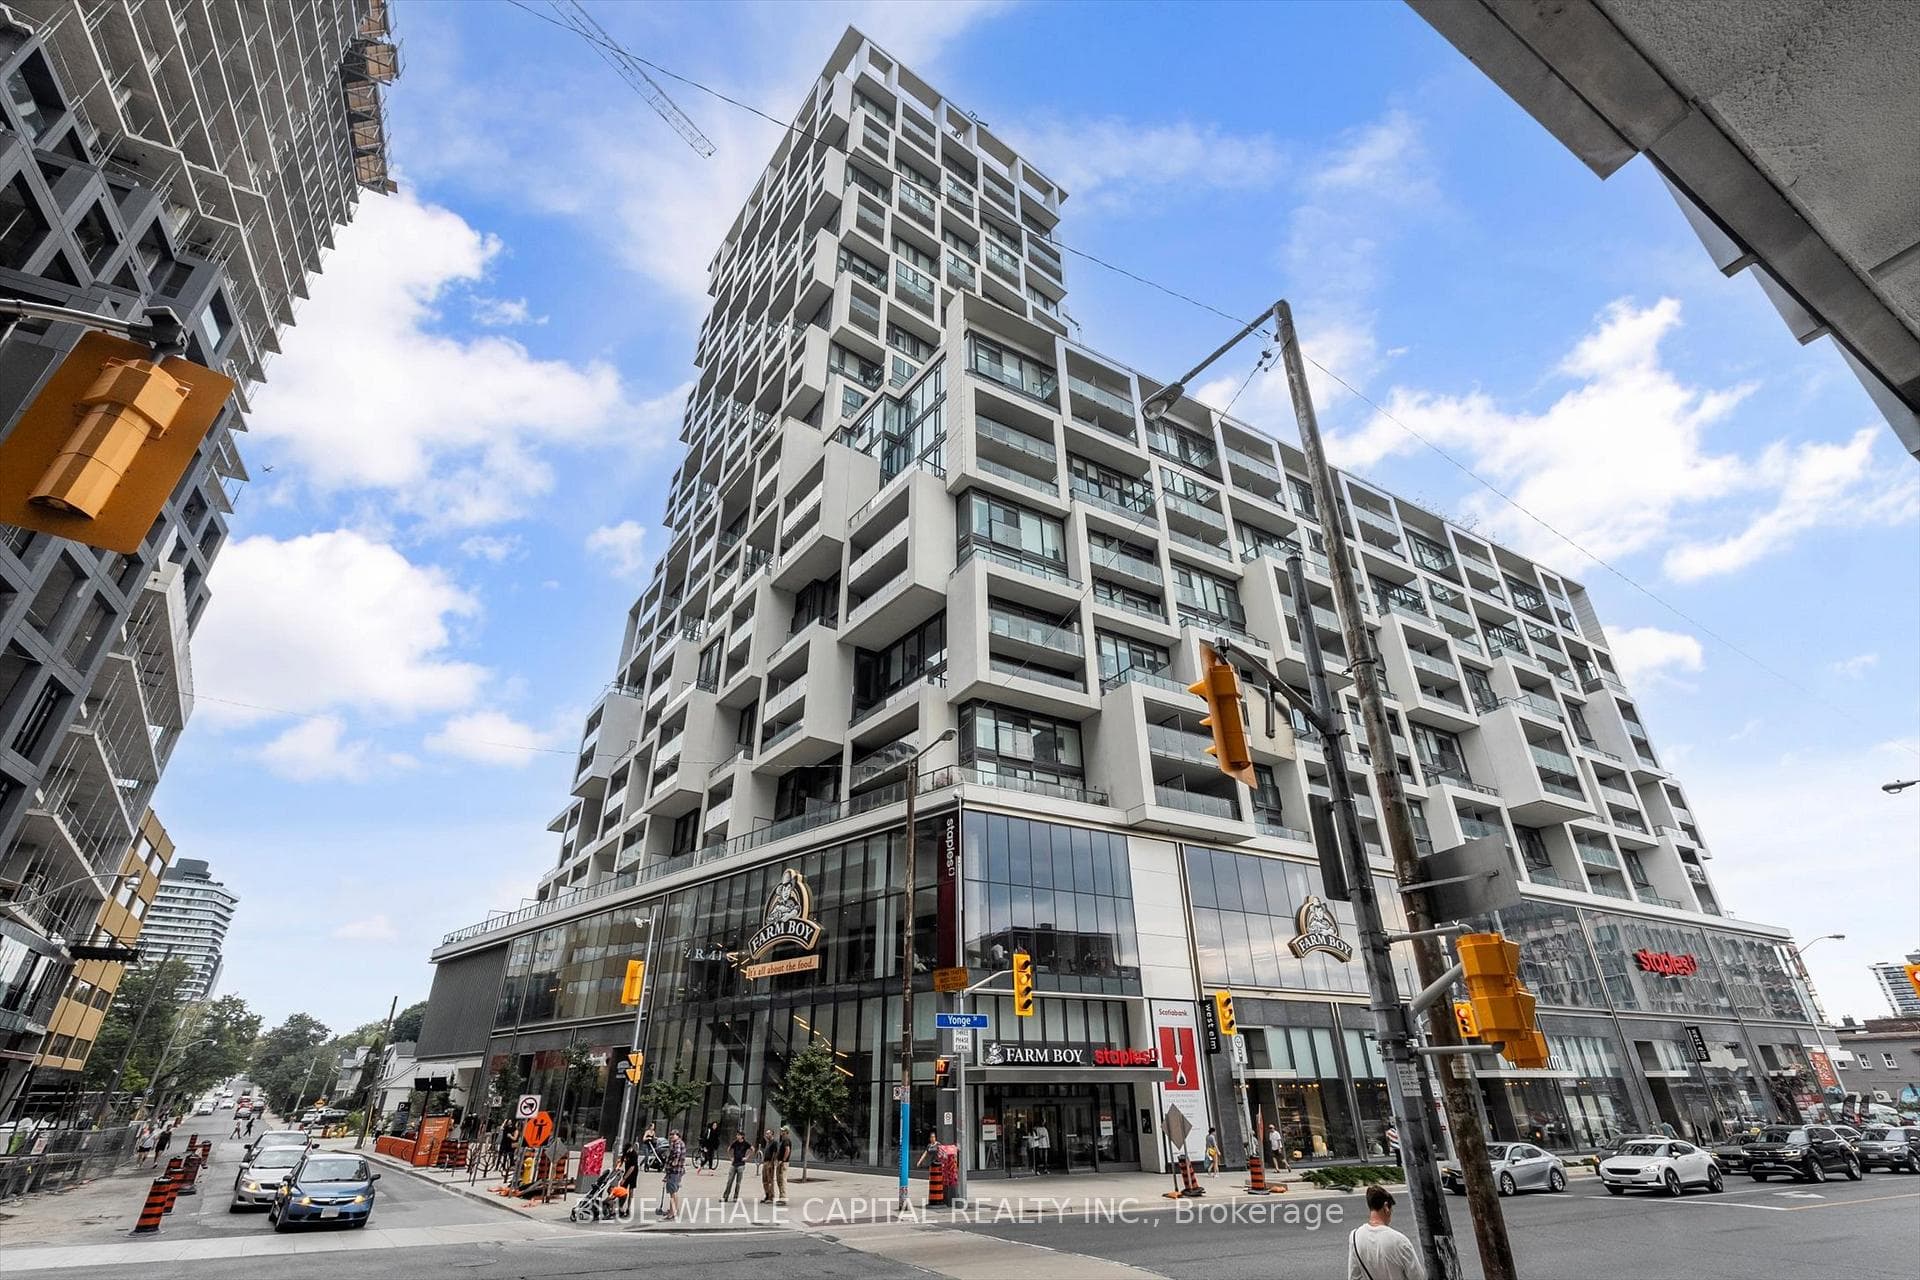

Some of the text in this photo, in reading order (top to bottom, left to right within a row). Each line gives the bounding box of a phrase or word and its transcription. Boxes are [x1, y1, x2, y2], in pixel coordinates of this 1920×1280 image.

[751, 920, 814, 952] FARM BOY
[1298, 934, 1352, 954] FARM BOY
[758, 966, 766, 975] all
[767, 965, 785, 974] about
[786, 962, 796, 970] the
[1158, 1008, 1189, 1017] Scotiabank
[947, 1015, 971, 1027] Yonge
[1205, 1004, 1217, 1050] west elm
[1006, 1048, 1084, 1063] FARM BOY
